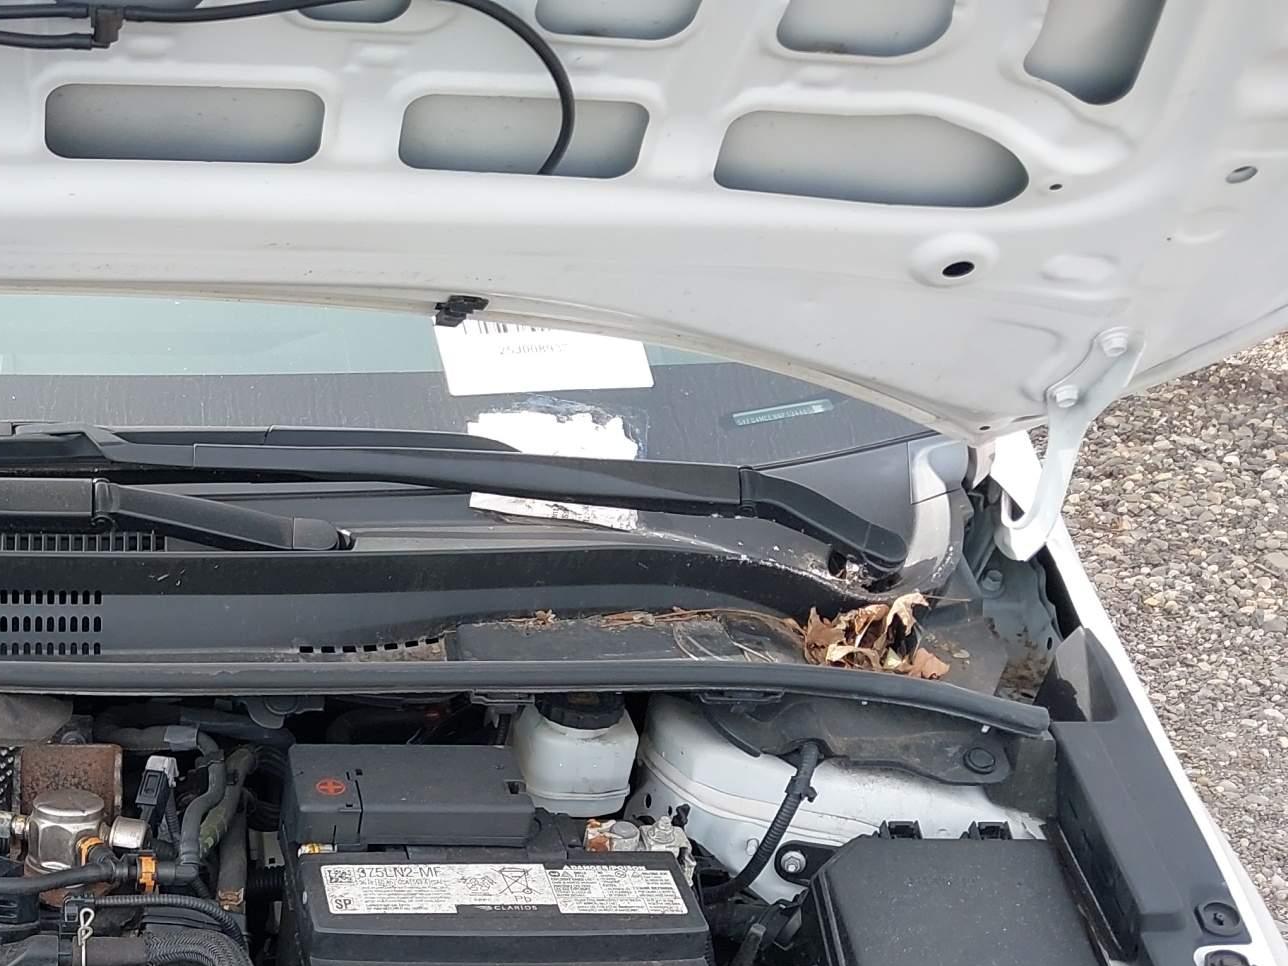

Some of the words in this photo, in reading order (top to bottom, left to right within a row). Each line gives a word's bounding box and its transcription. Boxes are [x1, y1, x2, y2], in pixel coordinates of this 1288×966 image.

[357, 866, 441, 879] 375LN2-MF
[334, 898, 352, 910] SP
[515, 894, 532, 903] Pb
